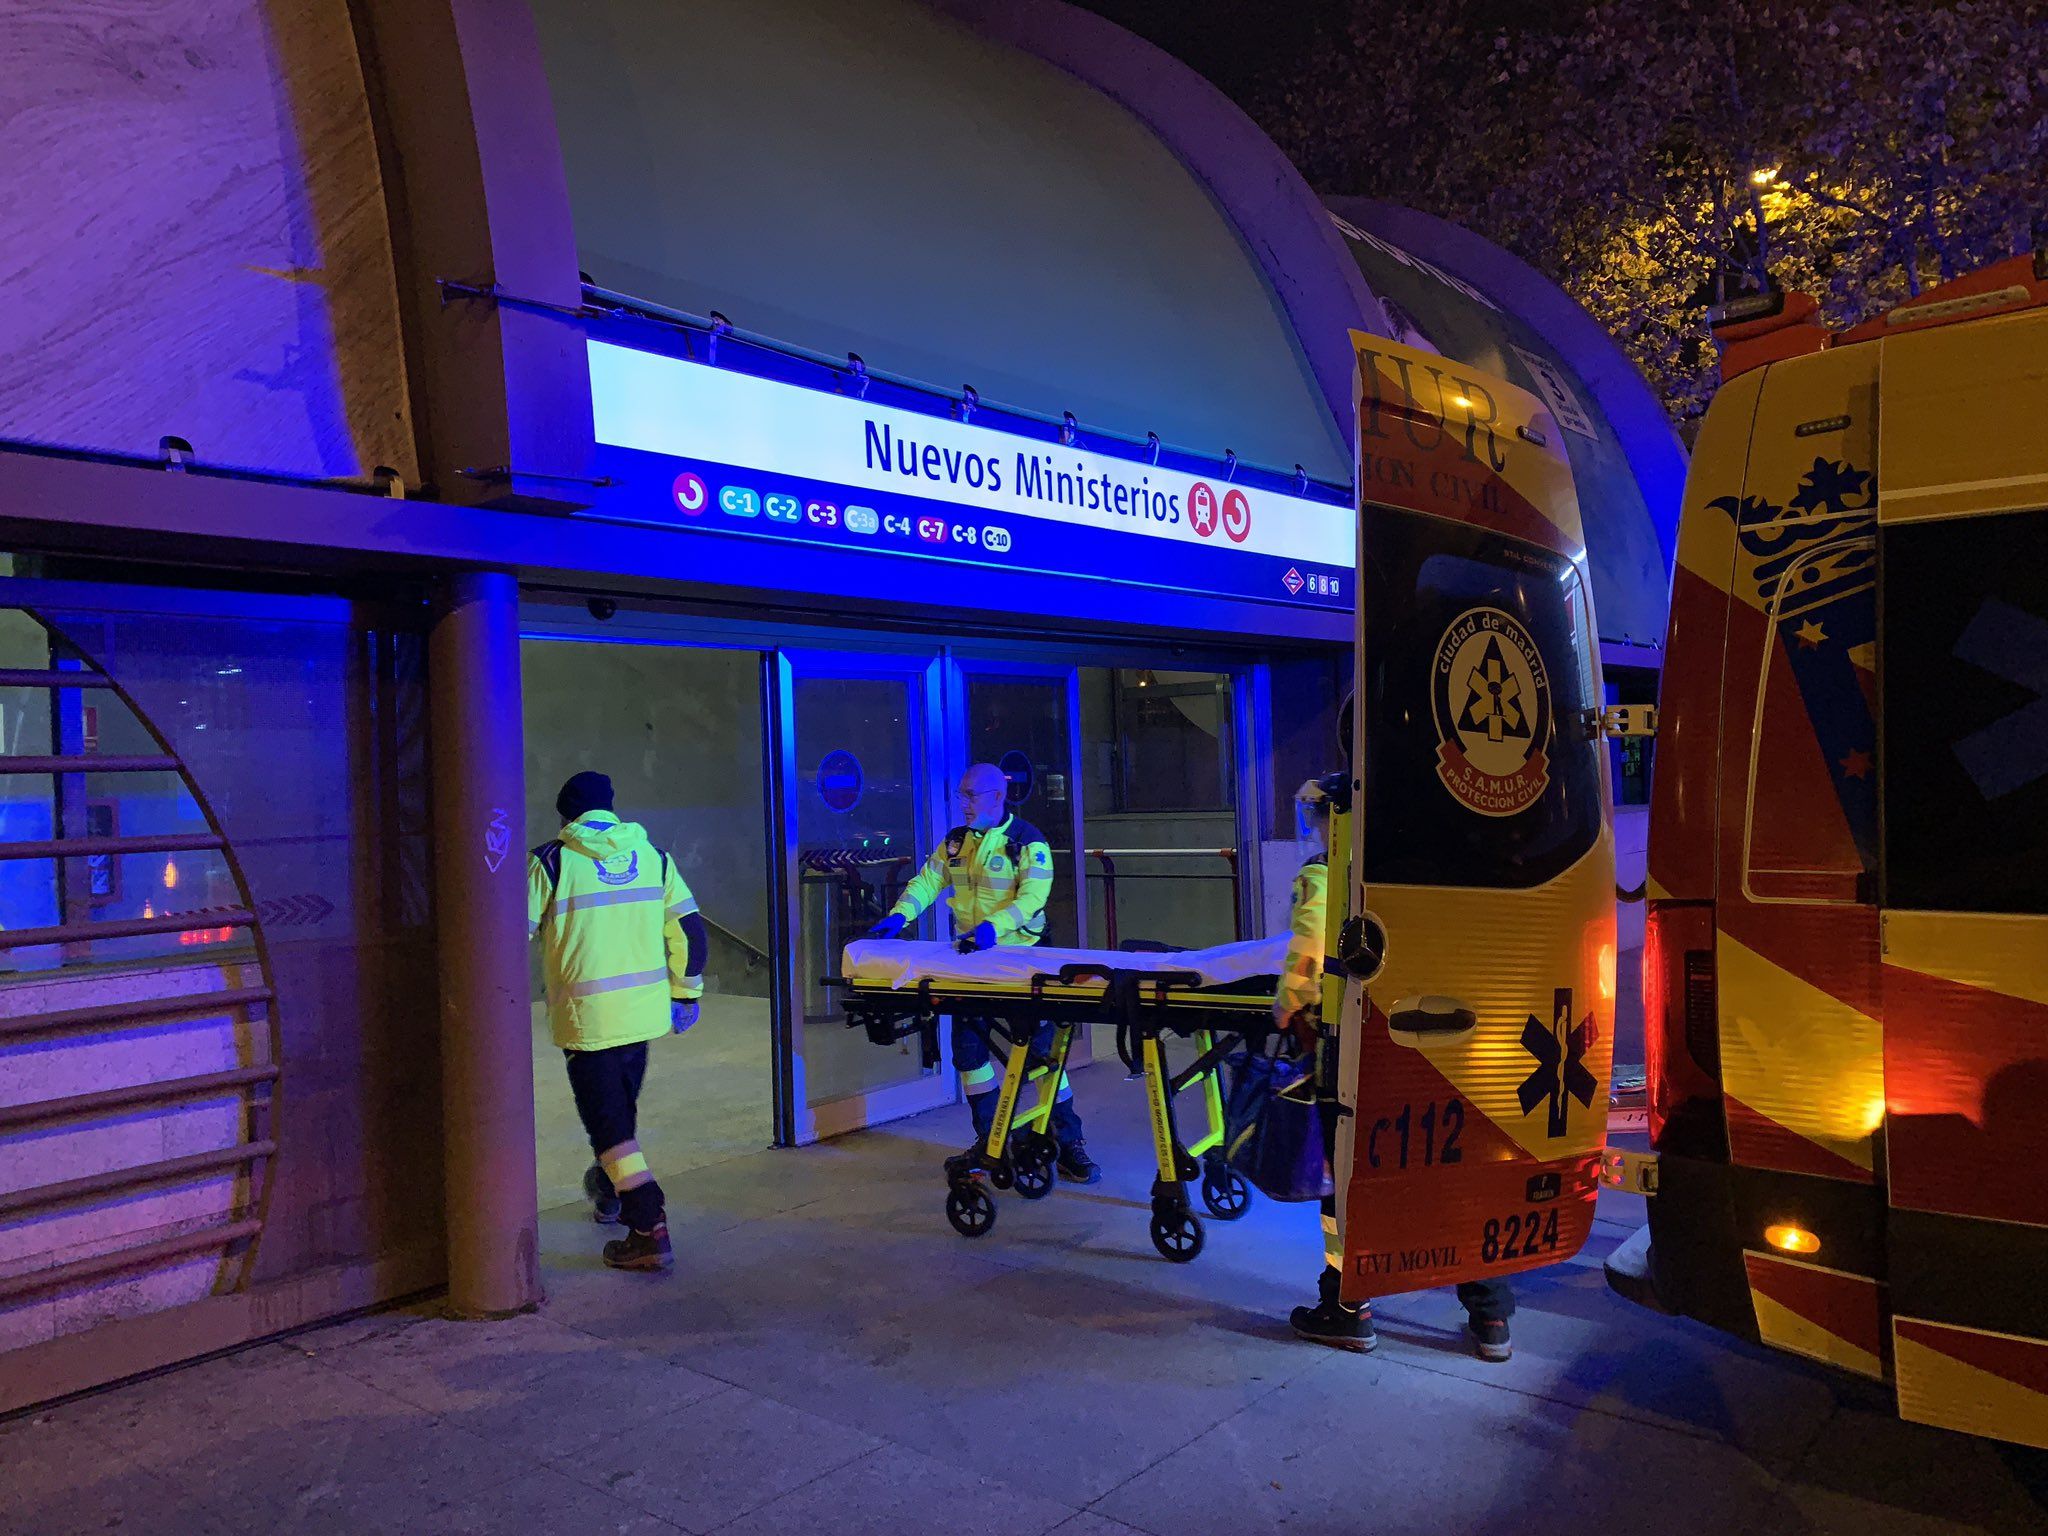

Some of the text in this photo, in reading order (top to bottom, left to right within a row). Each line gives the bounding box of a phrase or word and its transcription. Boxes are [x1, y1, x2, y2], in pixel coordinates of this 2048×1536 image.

[865, 419, 1180, 524] Nuevos Ministerios
[1431, 471, 1508, 515] CIVIL
[722, 490, 1008, 547] C-1 C-2 C-3 C-3a C-4 C-7 C-8 C-10
[1309, 576, 1339, 594] 6 8 10
[1440, 613, 1545, 689] ciudad de madrid
[1447, 768, 1543, 809] PROTECCION CIVIL
[1481, 1207, 1559, 1265] 8224
[1356, 1246, 1463, 1277] UVI MOVIL
